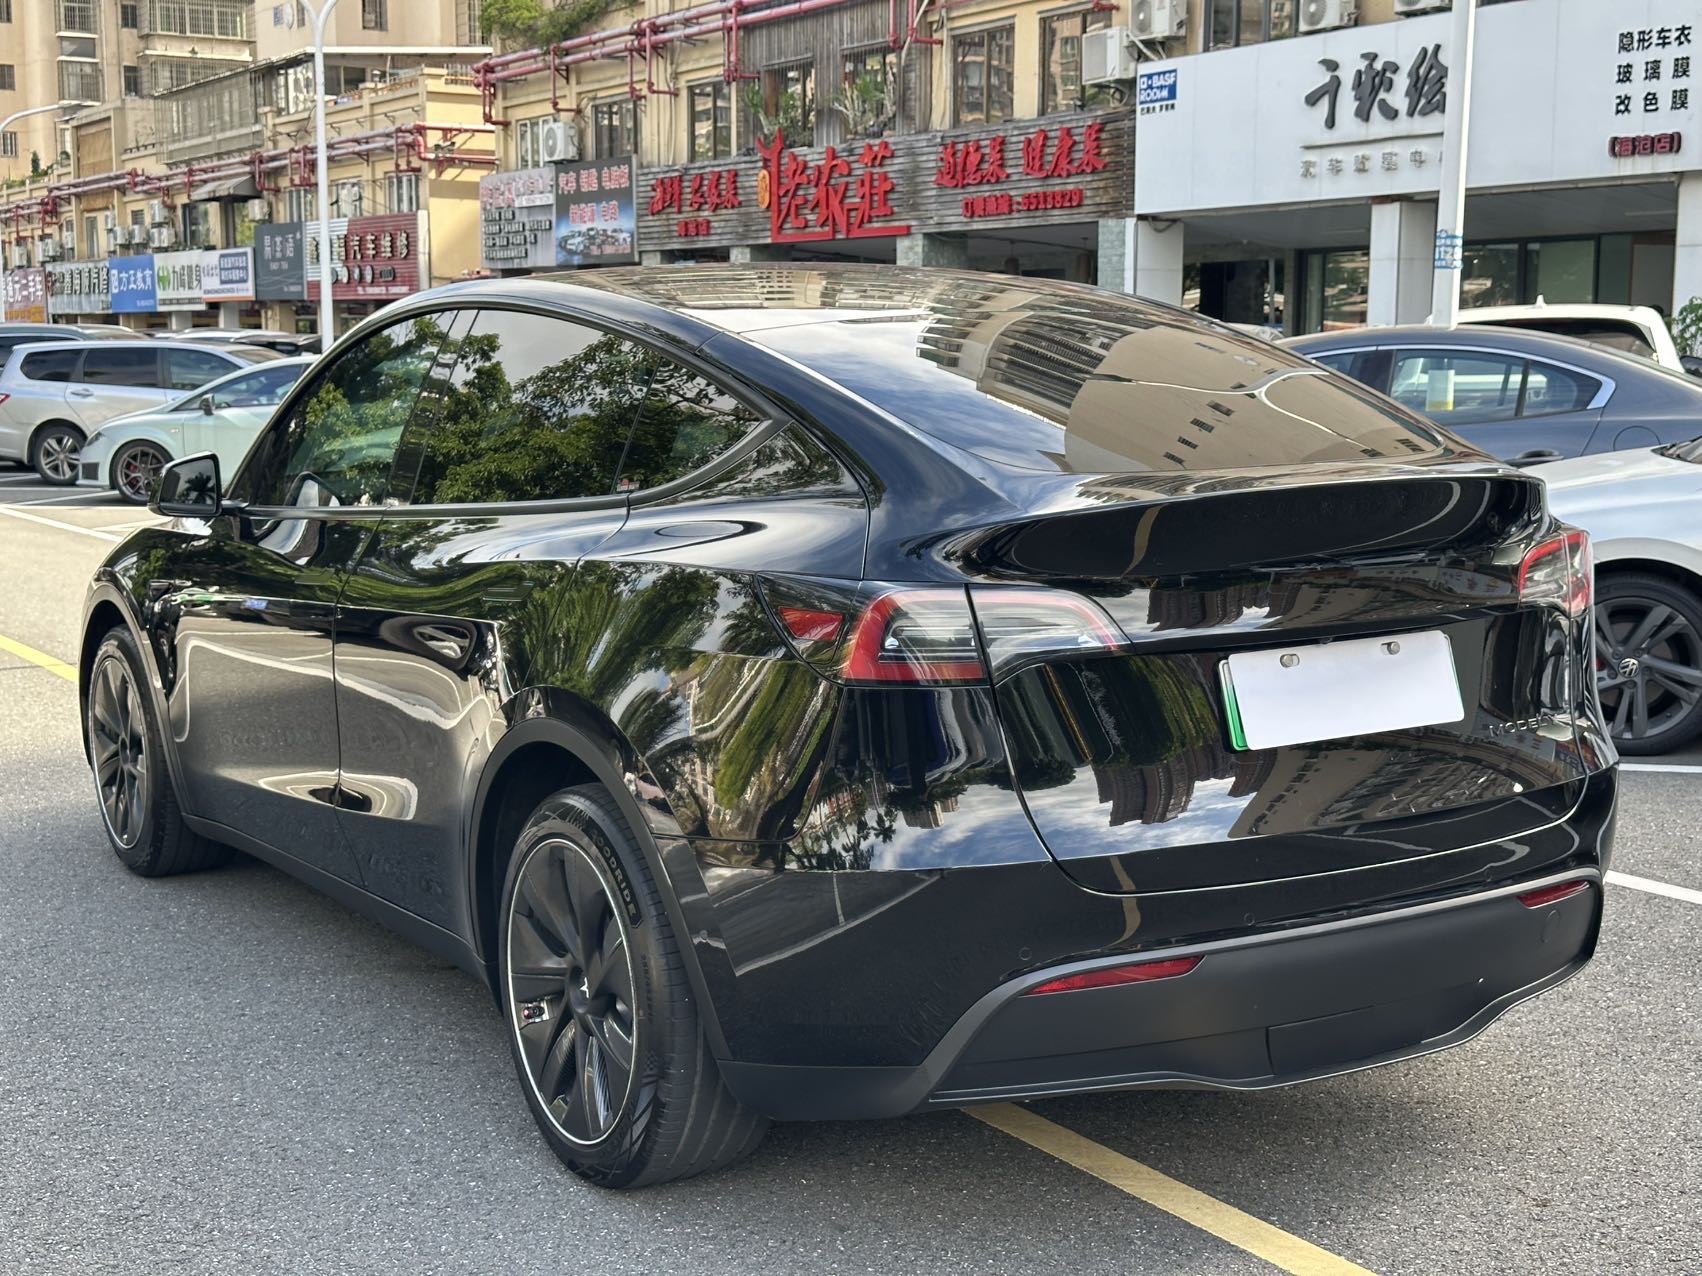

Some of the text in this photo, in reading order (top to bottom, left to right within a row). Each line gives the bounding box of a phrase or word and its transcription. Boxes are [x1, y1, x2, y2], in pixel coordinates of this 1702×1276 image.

[1618, 25, 1692, 53] 隐形车衣
[1152, 72, 1176, 88] BASF
[1615, 56, 1690, 84] 玻璃膜
[1614, 88, 1689, 116] 改色膜
[1022, 119, 1108, 178] 健康菜
[306, 230, 409, 264] 鑫福汽车维修
[1489, 716, 1547, 738] MODEL
